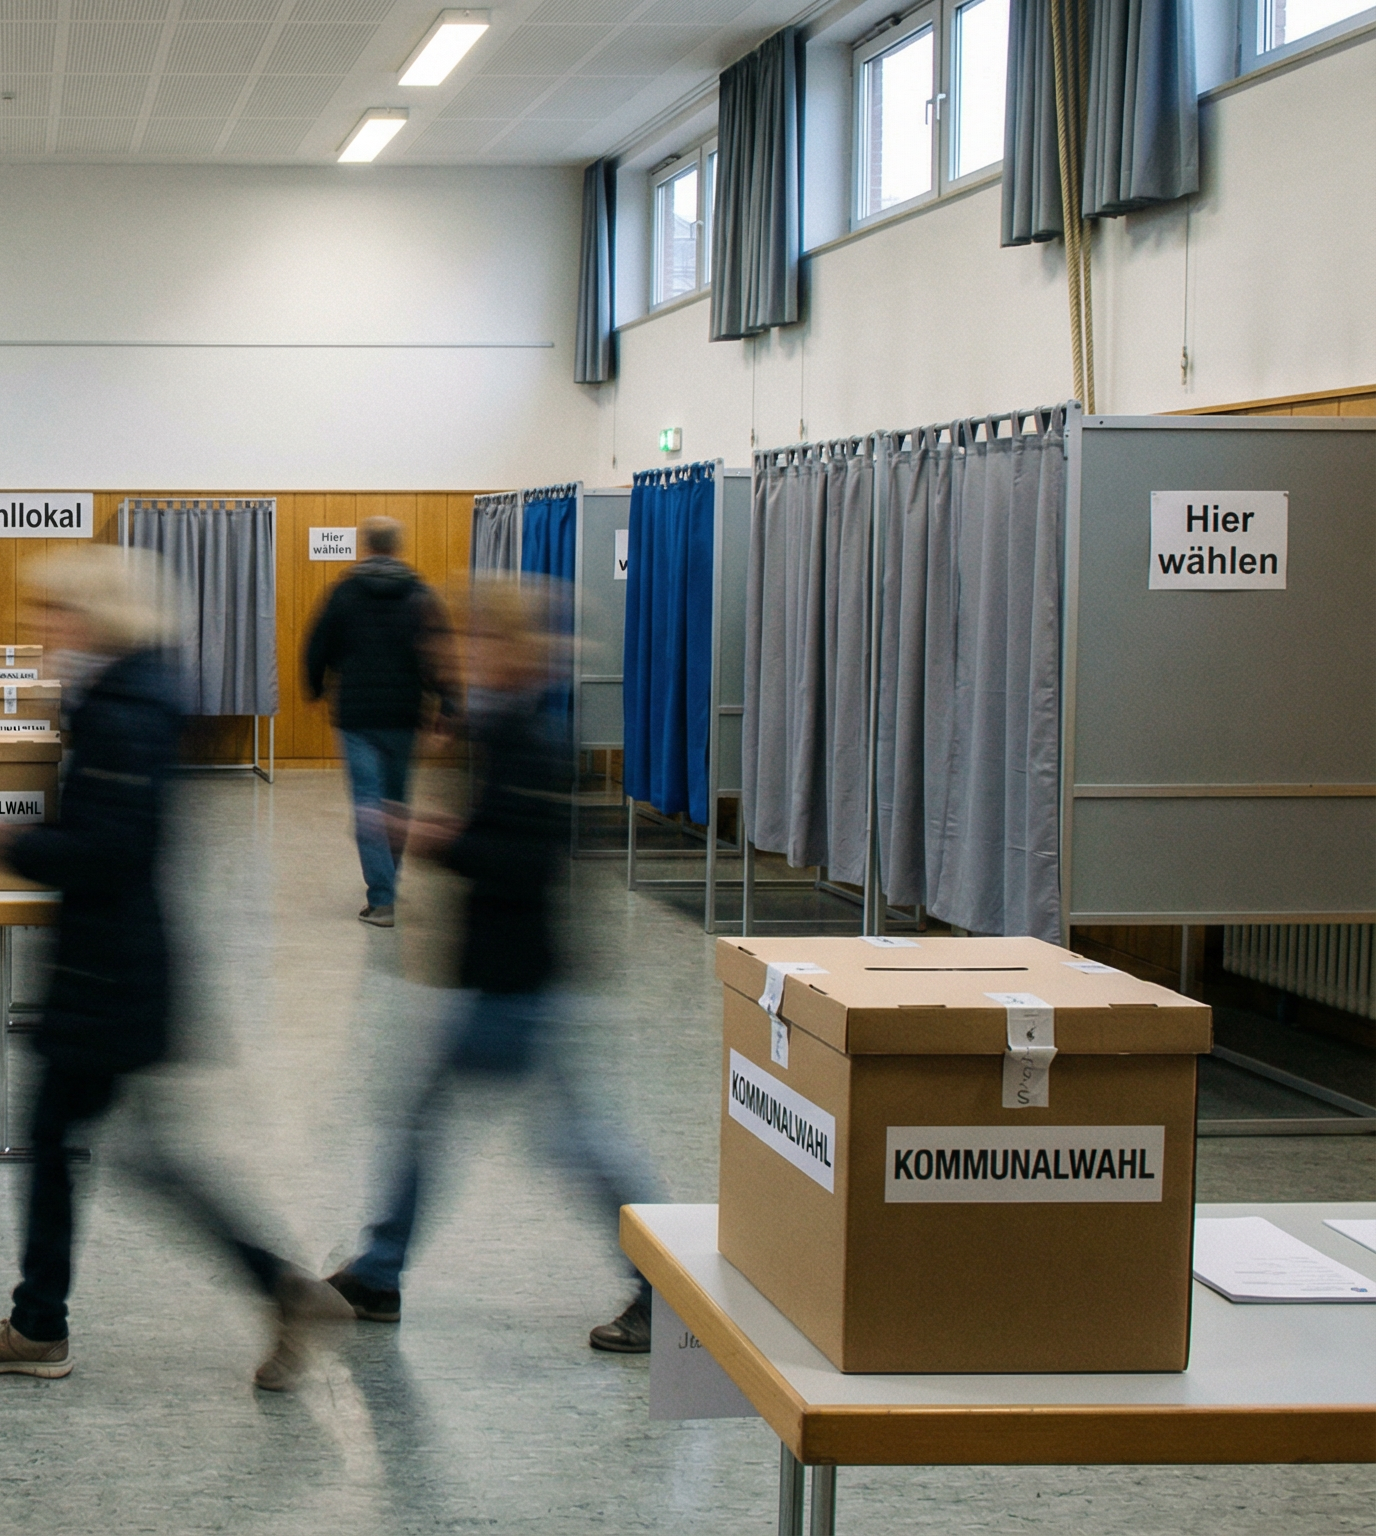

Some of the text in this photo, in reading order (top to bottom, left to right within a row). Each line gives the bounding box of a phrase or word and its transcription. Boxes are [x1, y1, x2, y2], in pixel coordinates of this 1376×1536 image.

[1186, 504, 1255, 533] Hier
[321, 532, 344, 542] Hier
[1157, 546, 1278, 575] wählen
[731, 1069, 832, 1169] KOMMUNALWAHL
[893, 1148, 1156, 1181] KOMMUNALWAHL
